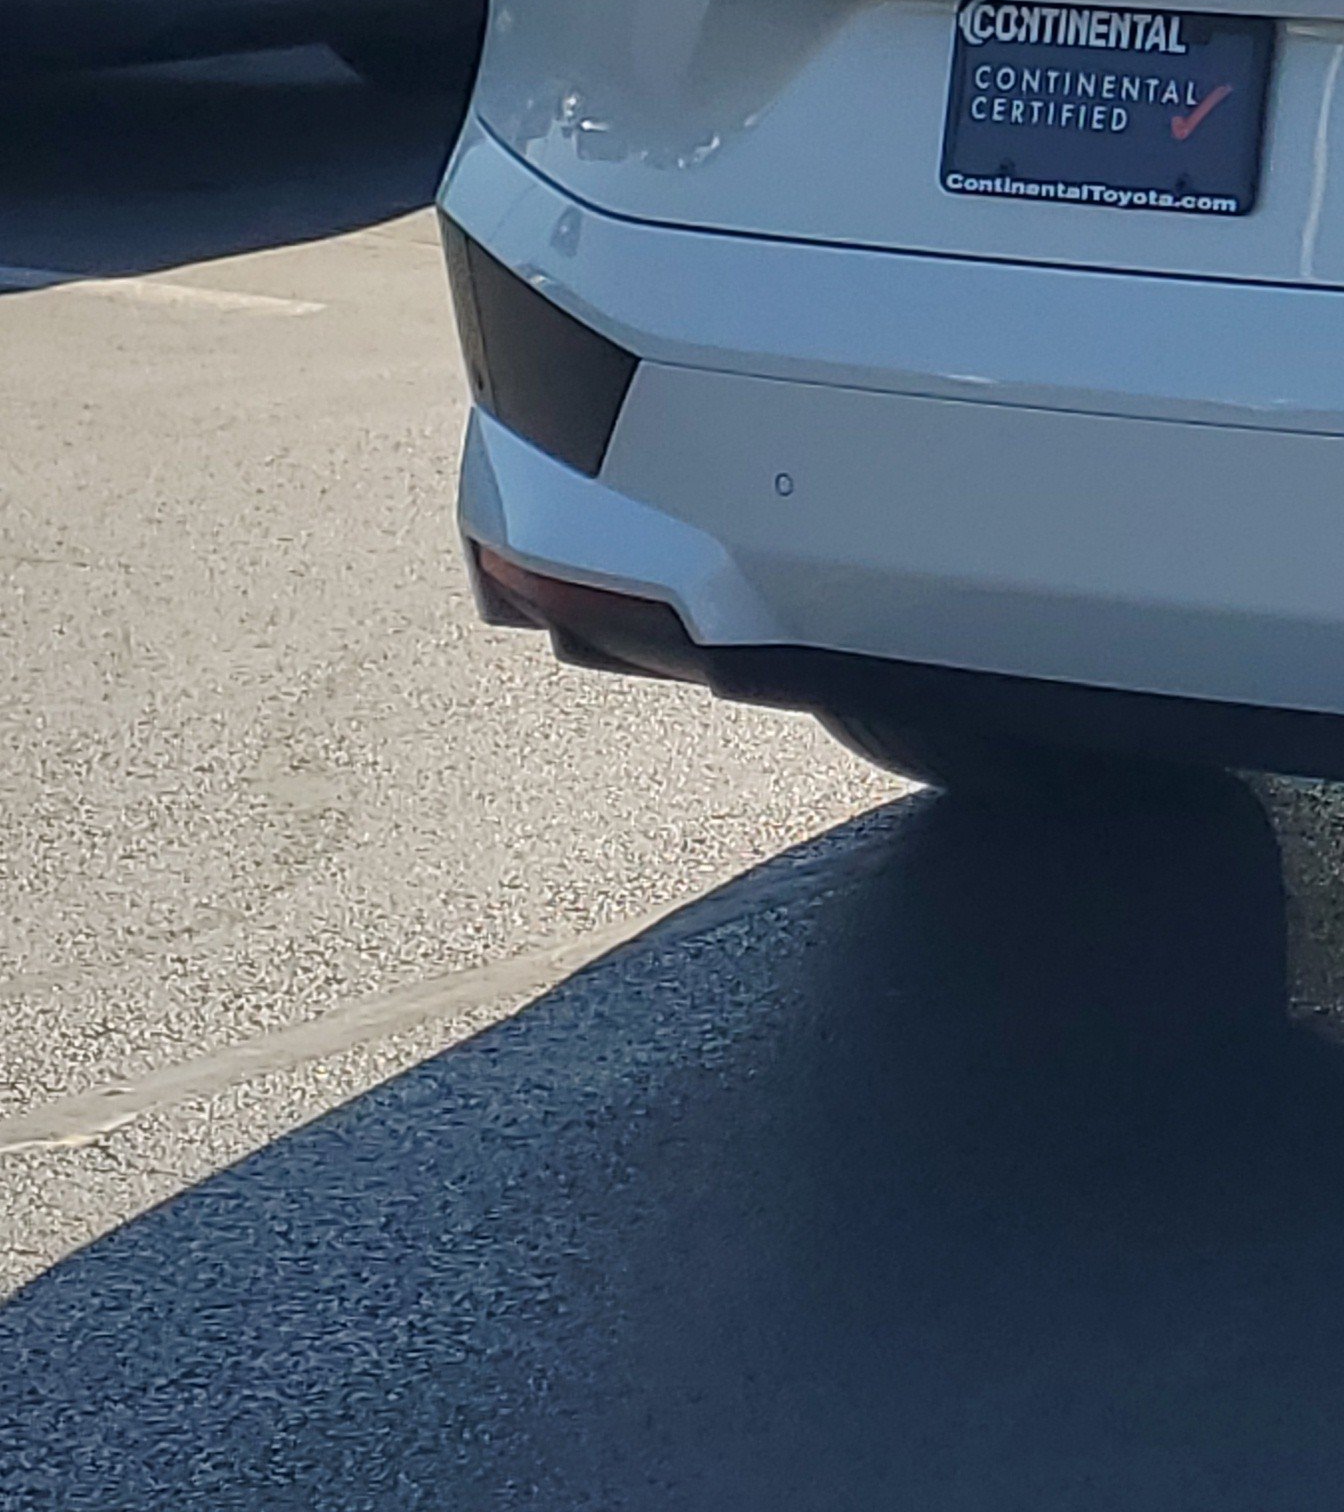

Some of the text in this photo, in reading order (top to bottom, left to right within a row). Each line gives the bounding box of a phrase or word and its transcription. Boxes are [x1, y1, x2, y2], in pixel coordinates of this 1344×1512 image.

[966, 2, 1187, 54] CONTINENTAL
[974, 65, 1201, 106] CONTINENTAL
[971, 95, 1129, 133] CERTIFIED
[945, 172, 1238, 213] ContinentalToyota.com
